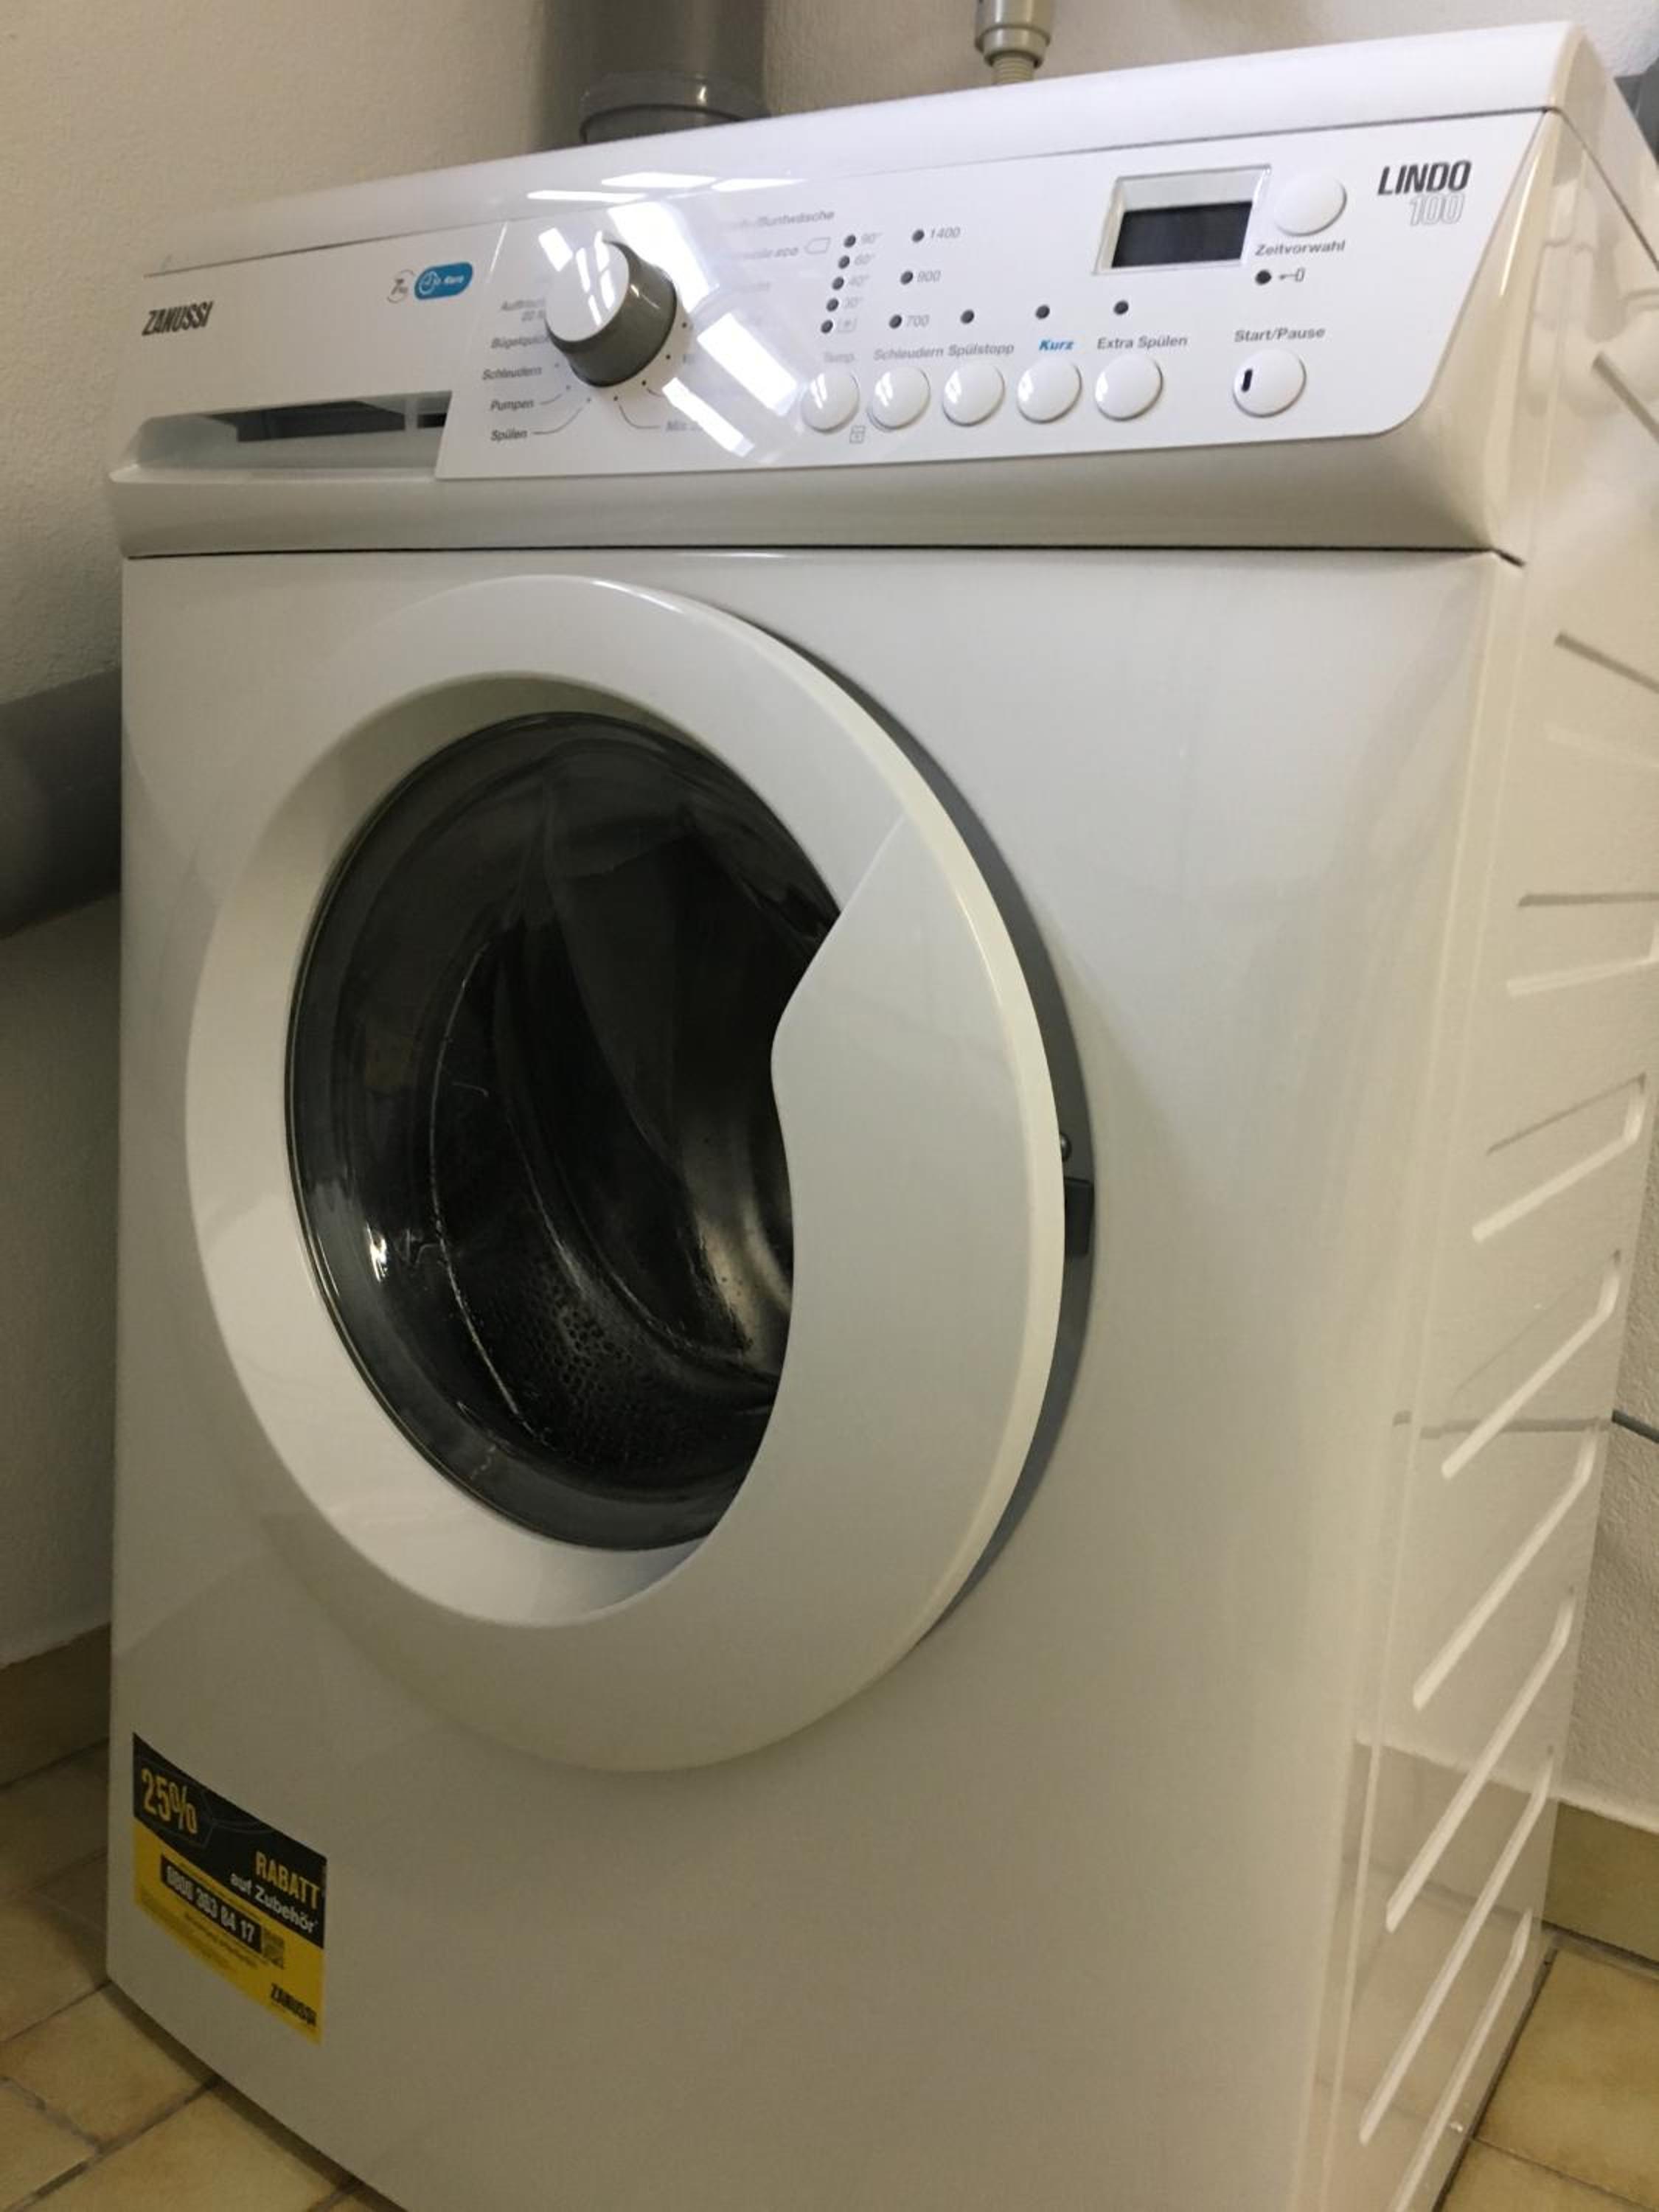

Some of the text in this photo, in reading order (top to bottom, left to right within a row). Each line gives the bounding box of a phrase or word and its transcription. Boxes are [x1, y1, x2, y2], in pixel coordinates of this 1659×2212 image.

[1377, 160, 1471, 196] LINDO
[1409, 192, 1465, 226] 100
[929, 226, 961, 240] 1400
[1255, 240, 1346, 256] Zeitvorwahl
[917, 270, 941, 283] 900
[142, 300, 215, 336] ZANUSSI
[906, 314, 930, 327] 700
[1096, 333, 1188, 350] Extra Spülen
[1234, 325, 1326, 342] Start/Pause
[873, 342, 1015, 361] Schleudern Spülstopp
[1039, 337, 1074, 351] Kurz
[482, 367, 542, 380] Schleudern
[490, 400, 535, 411] Pumpen
[490, 428, 528, 442] Spülen
[141, 1767, 198, 1835] 25%
[230, 1872, 251, 1898] auf
[255, 1851, 321, 1910] RABATT
[239, 1919, 255, 1944] 17
